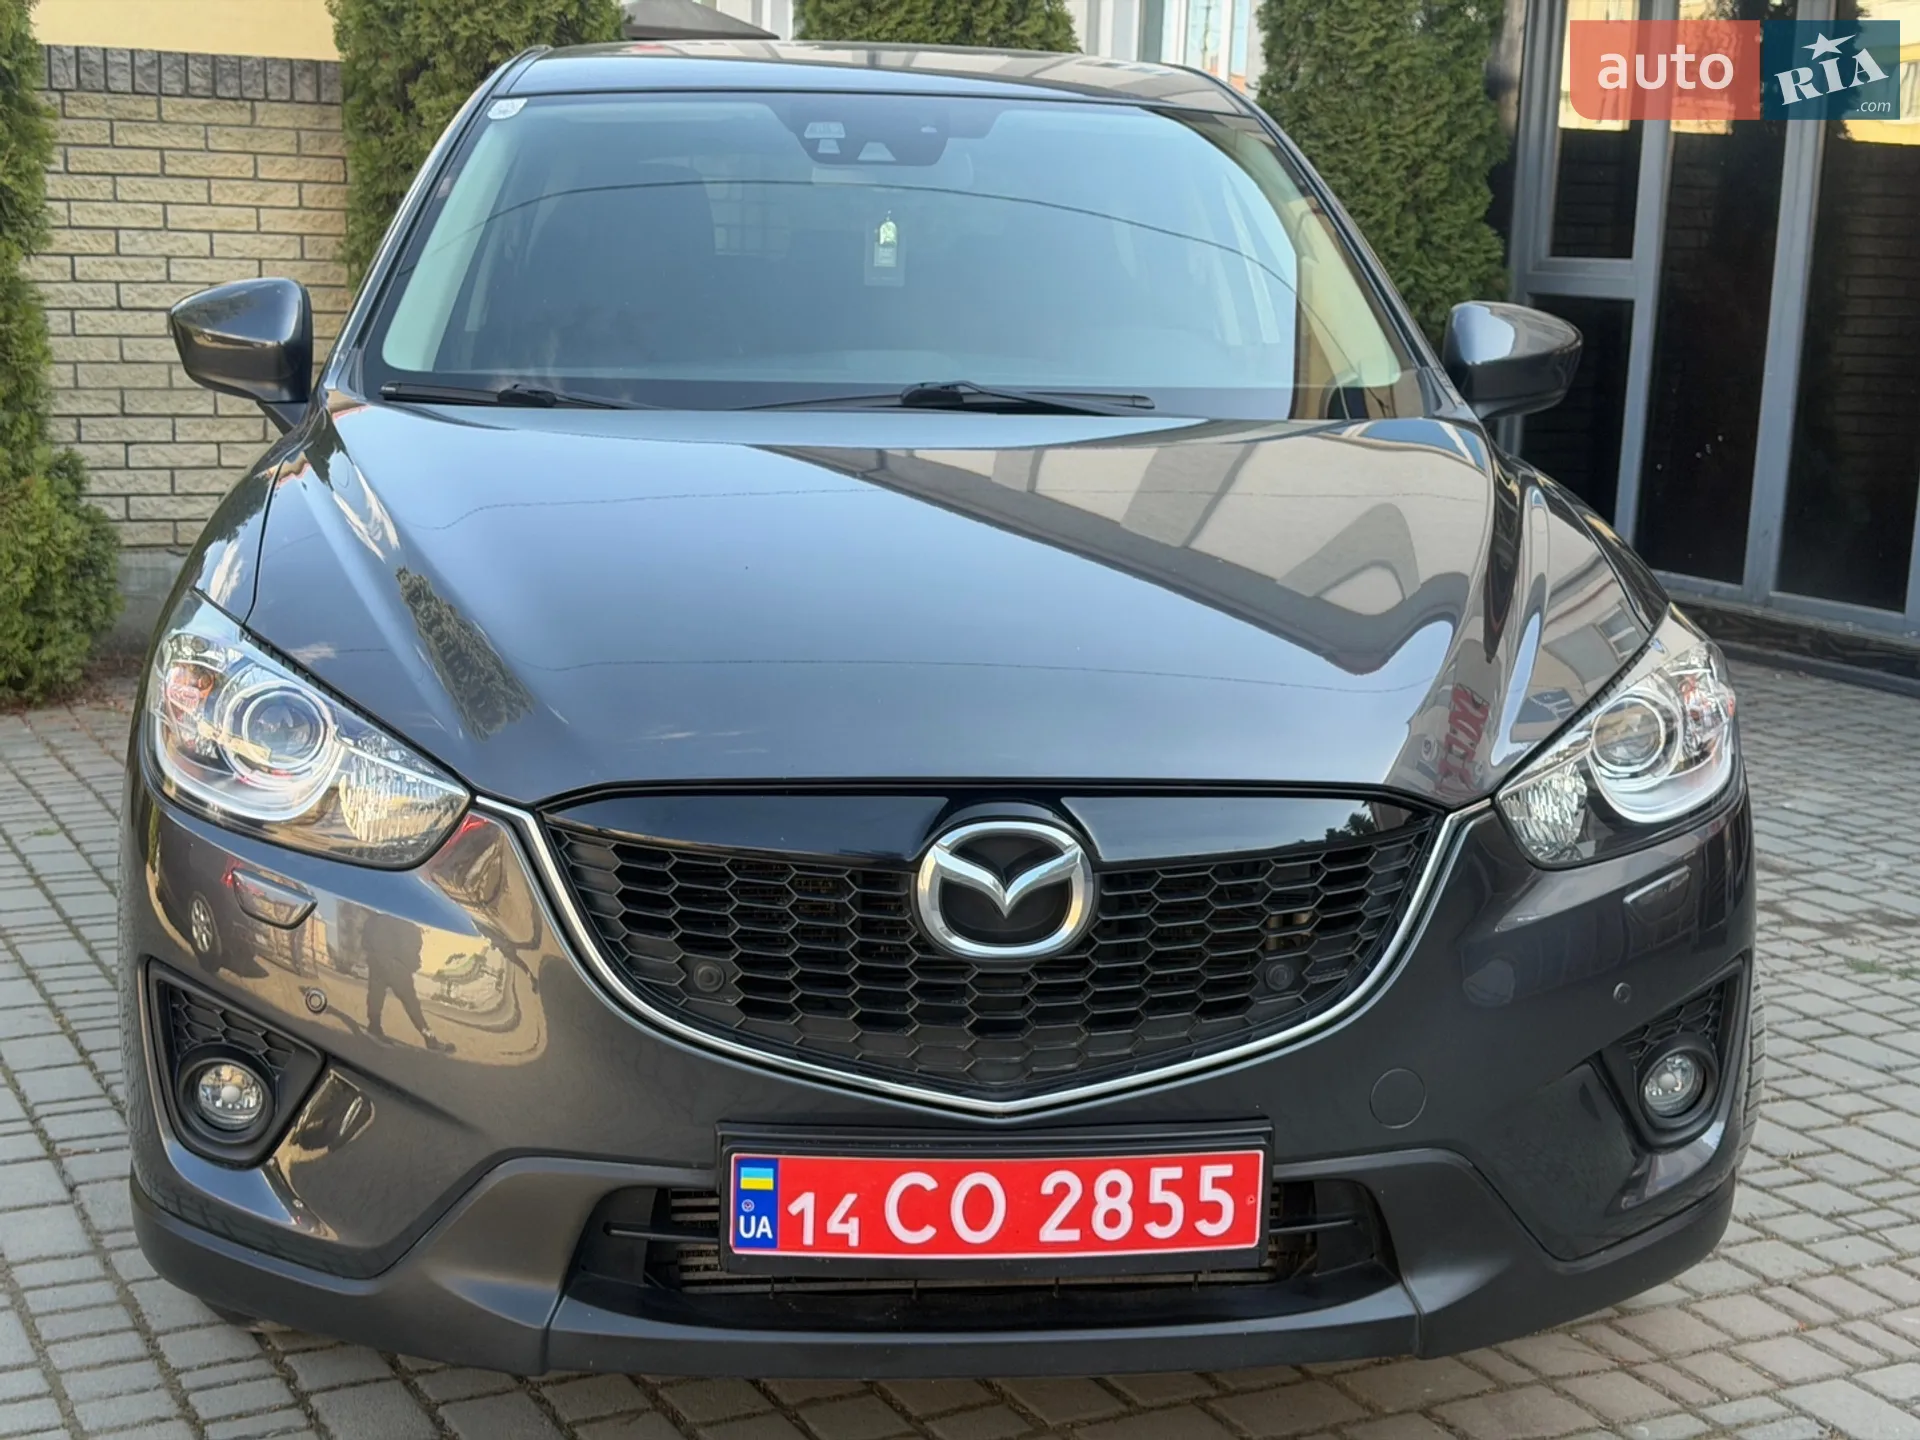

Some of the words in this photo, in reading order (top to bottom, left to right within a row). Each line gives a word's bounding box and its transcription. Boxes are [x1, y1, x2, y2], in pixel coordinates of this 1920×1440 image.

[739, 1214, 773, 1239] UA
[787, 1191, 860, 1248] 14
[884, 1170, 1007, 1245] CO
[1038, 1164, 1235, 1244] 2855
